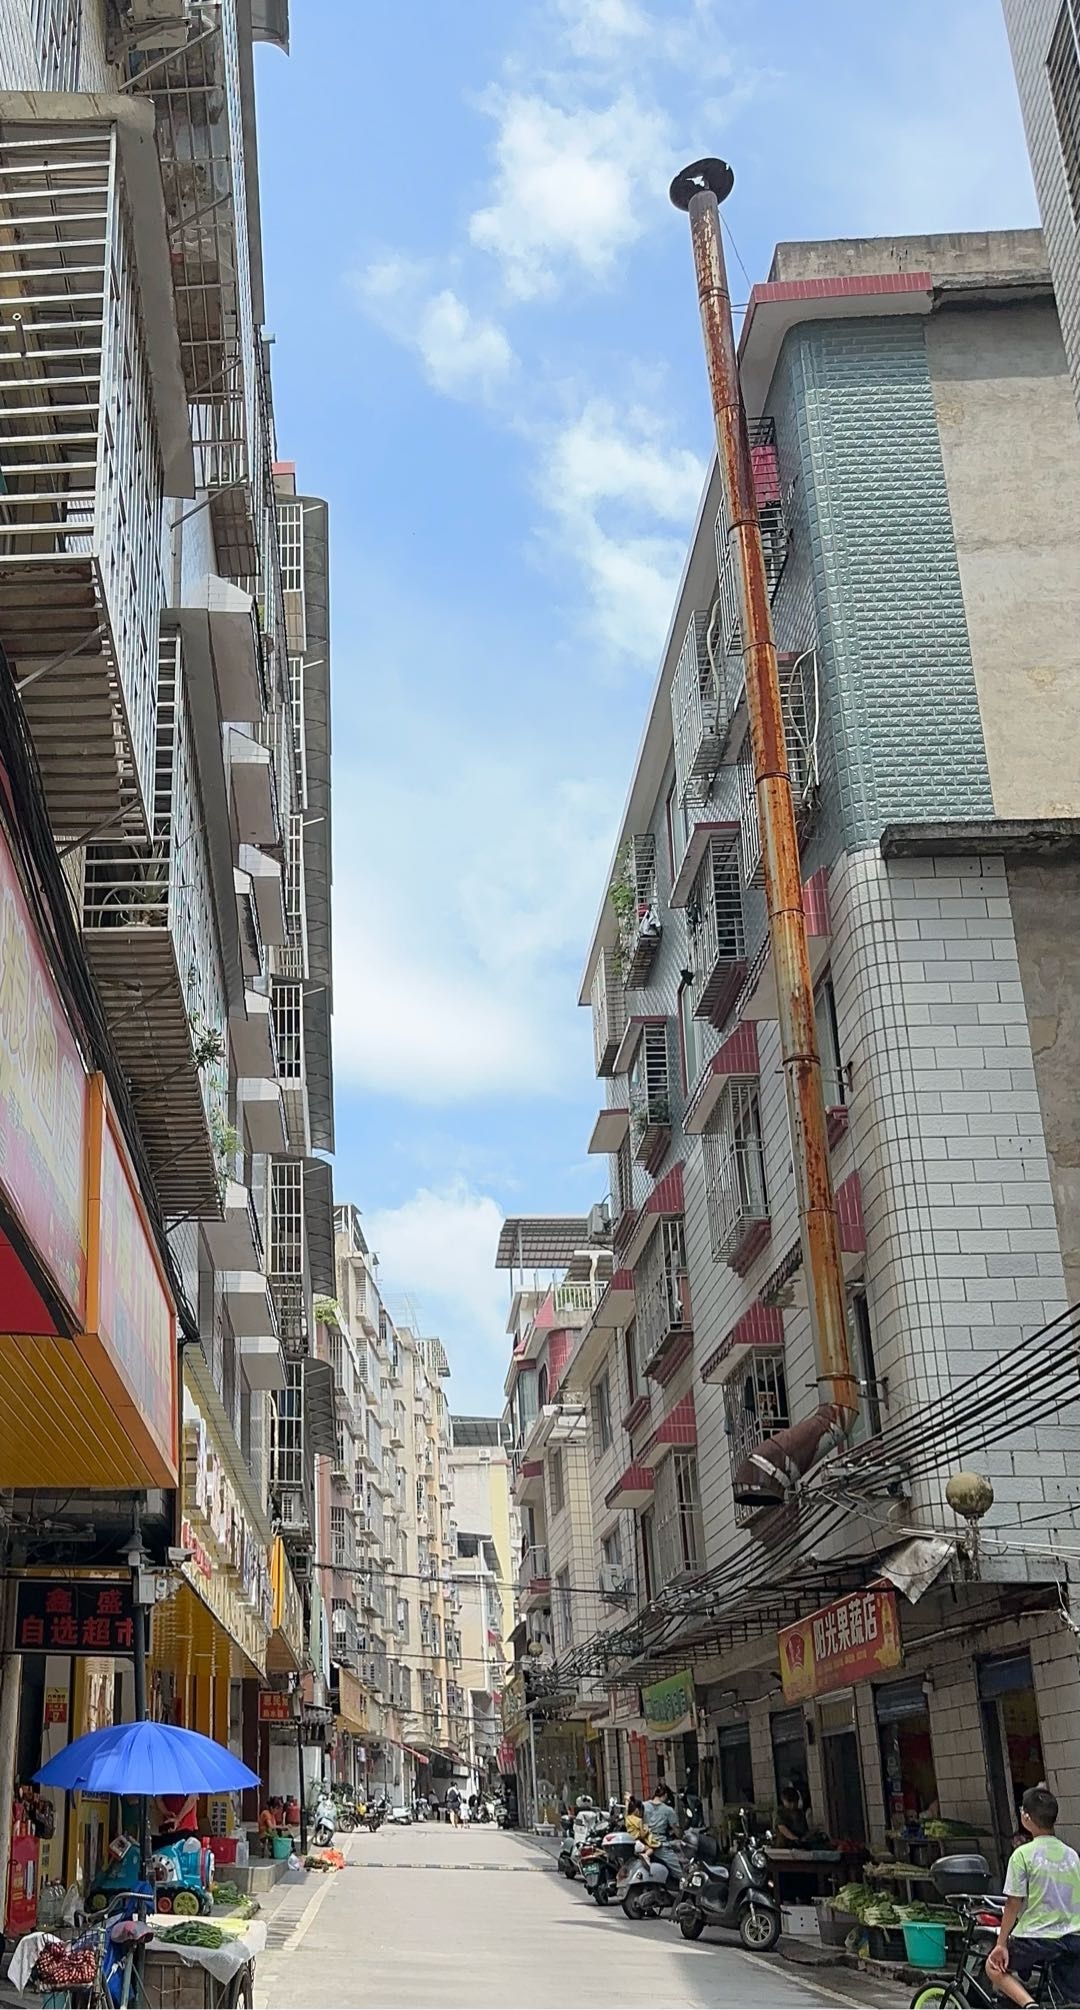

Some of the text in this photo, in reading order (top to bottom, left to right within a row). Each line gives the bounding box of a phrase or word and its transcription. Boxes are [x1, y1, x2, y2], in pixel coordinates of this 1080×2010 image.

[46, 1587, 123, 1614] 鑫盛
[813, 1592, 878, 1661] 阳光果蔬店
